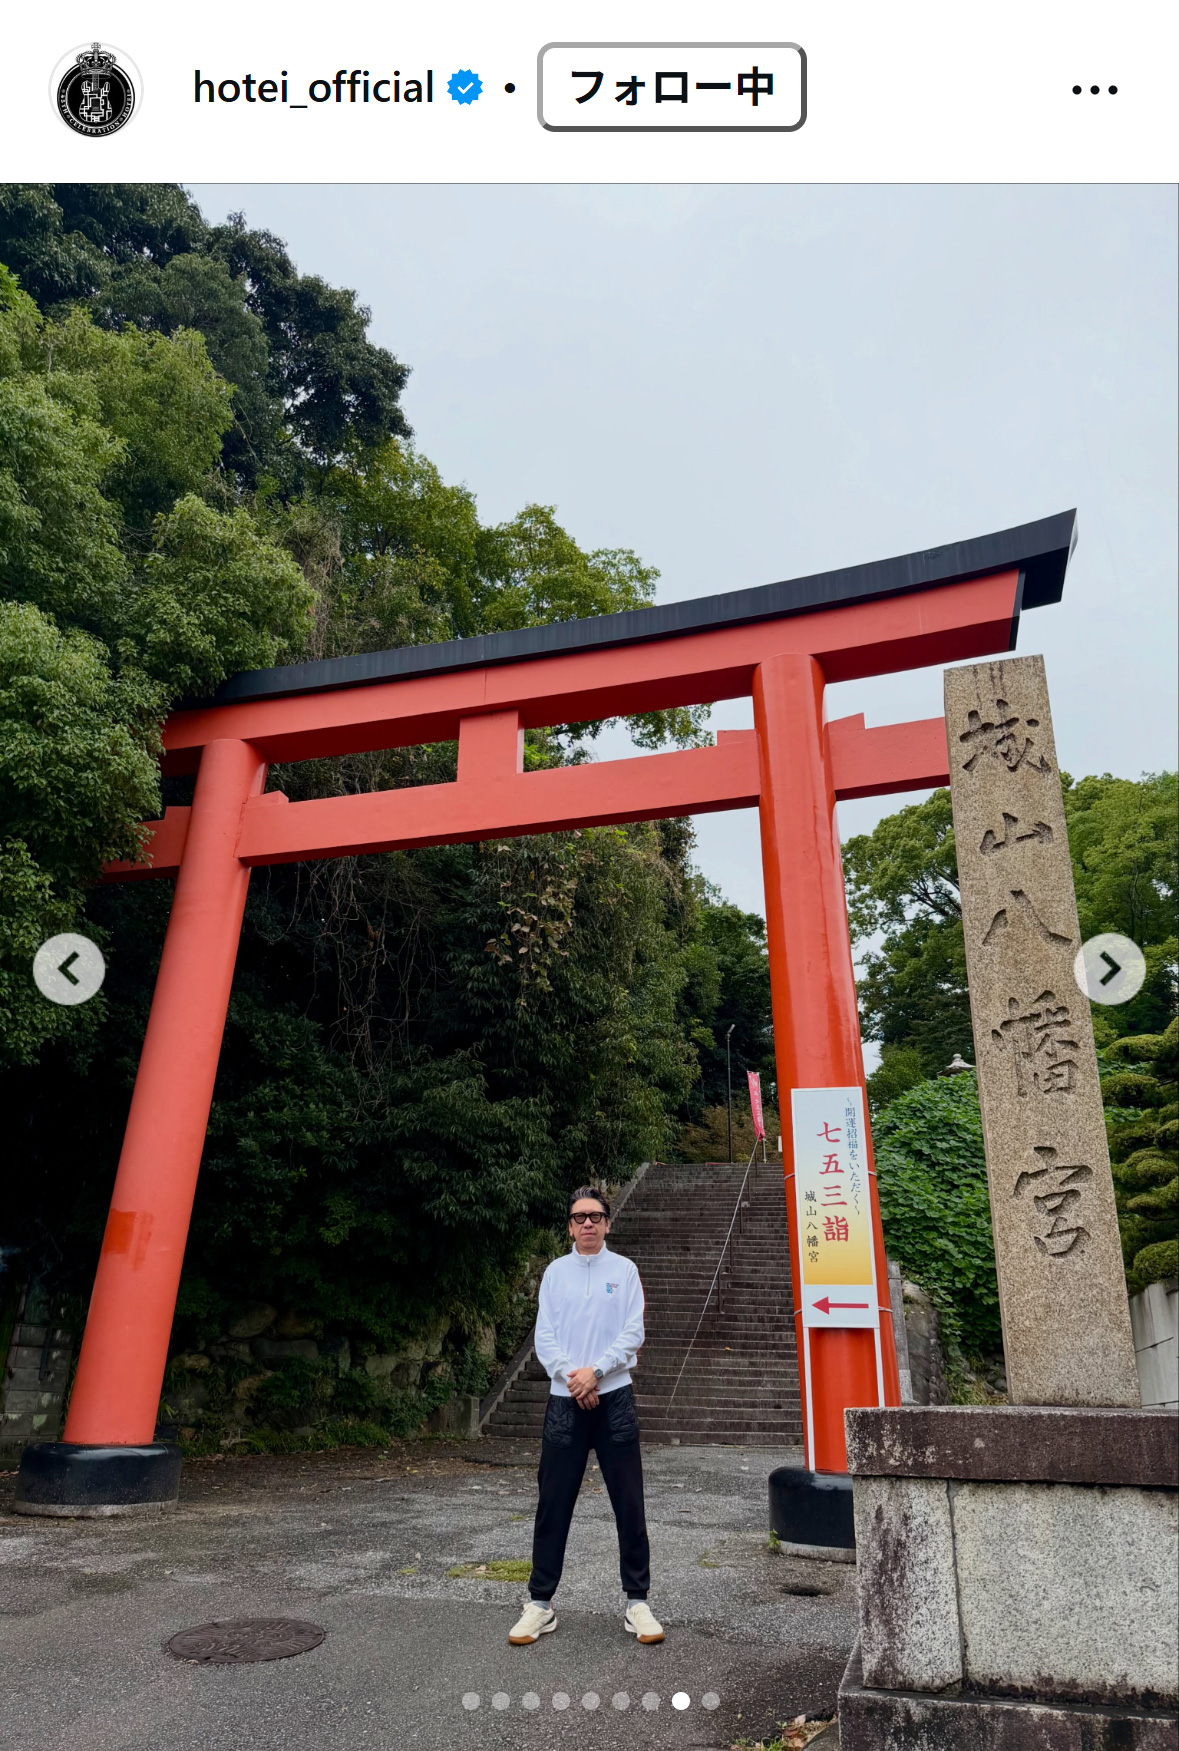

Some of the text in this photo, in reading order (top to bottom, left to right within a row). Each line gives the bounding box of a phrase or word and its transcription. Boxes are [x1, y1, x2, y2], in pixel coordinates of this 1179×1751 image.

[958, 698, 1094, 1260] 城山八幡宮
[804, 1190, 819, 1263] 城山八幡宮
[816, 1121, 849, 1243] 七五三詣
